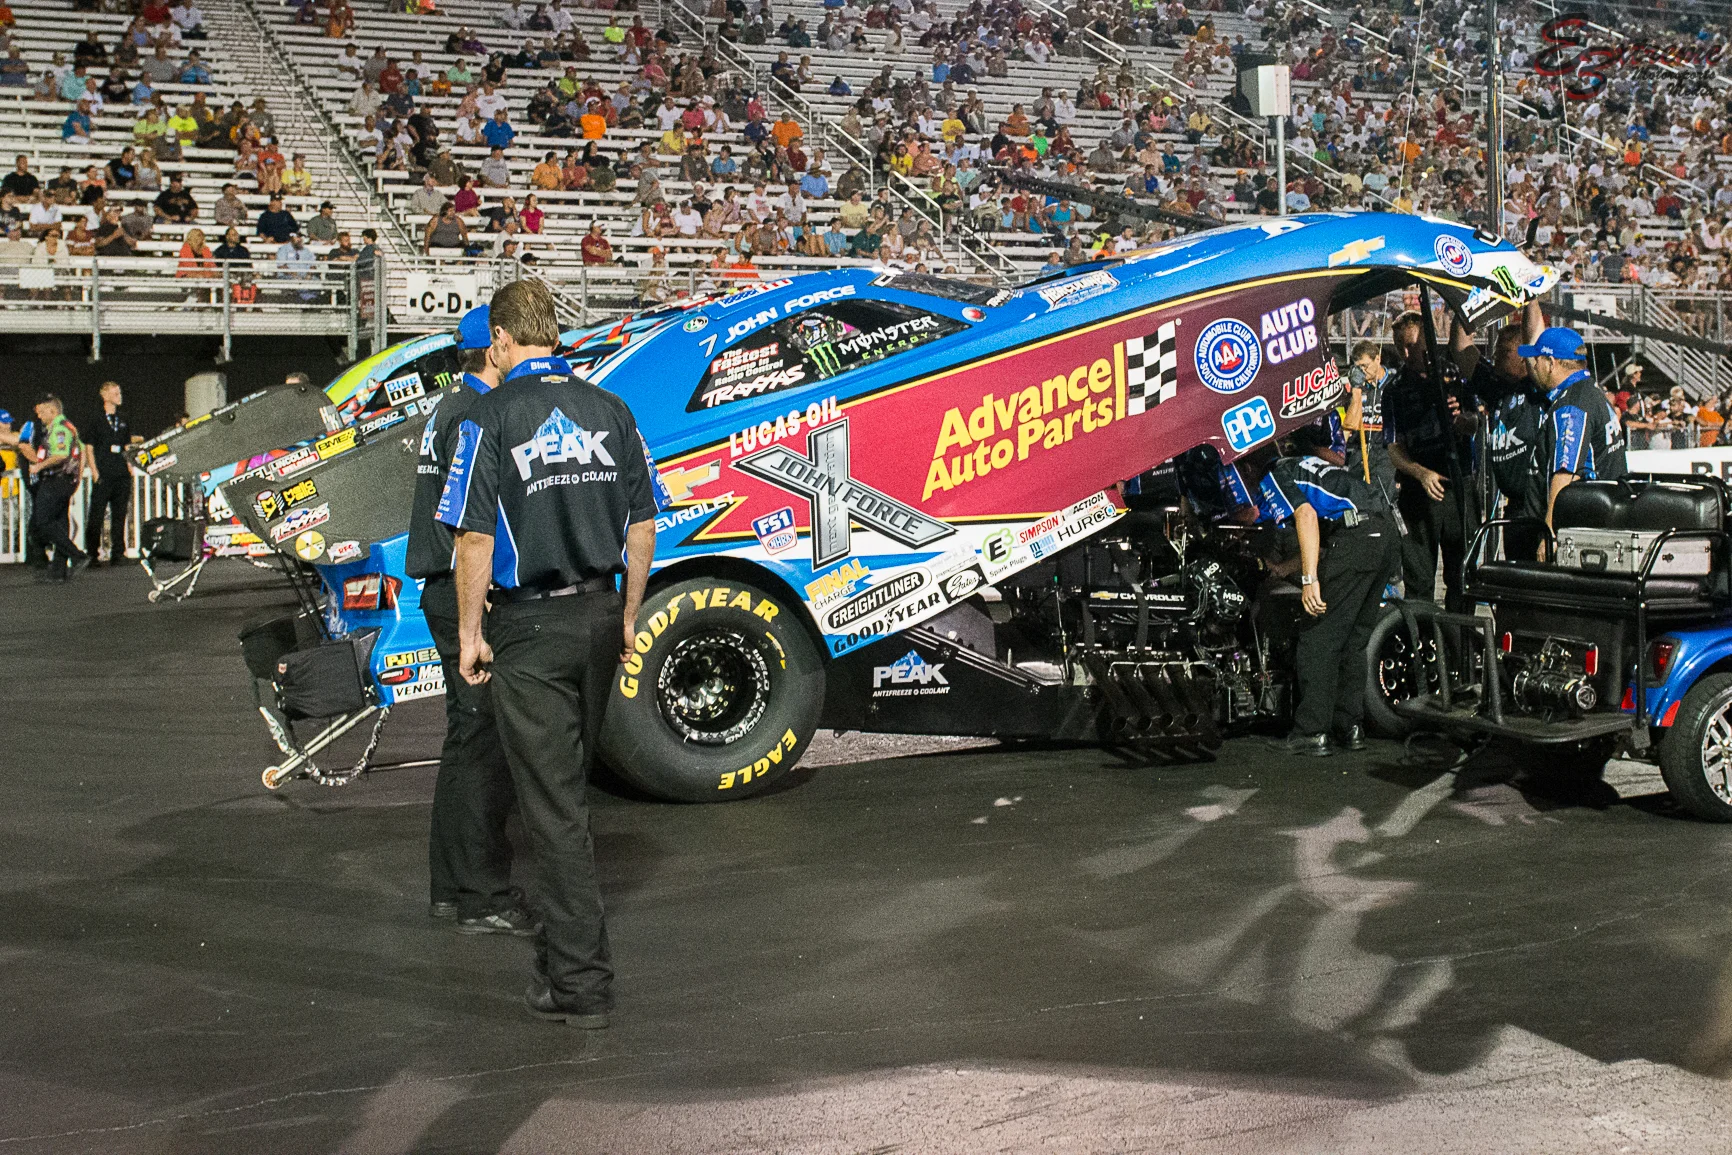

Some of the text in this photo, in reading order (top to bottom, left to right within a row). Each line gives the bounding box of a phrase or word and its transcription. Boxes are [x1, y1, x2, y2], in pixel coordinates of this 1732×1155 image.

[724, 284, 856, 344] JOHN FORCE
[1261, 299, 1315, 341] AUTO
[404, 336, 453, 359] COURTNEY
[698, 333, 718, 358] 7
[722, 347, 743, 360] The
[861, 331, 930, 360] ENERGY
[1198, 321, 1251, 360] AUTOMOBILE CLUB
[1214, 343, 1243, 366] AAA
[1266, 324, 1318, 365] CLUB
[711, 343, 779, 374] Fastest
[714, 358, 784, 387] Radio Control
[726, 361, 755, 376] Name
[1200, 342, 1260, 390] SOUTHERN CALIFORNIA
[387, 377, 418, 392] Blue
[389, 384, 420, 401] DEF
[701, 364, 806, 408] TRAXXAS
[1283, 356, 1340, 404] LUCAS
[934, 357, 1113, 460] Advance
[1287, 391, 1322, 417] SLICK
[360, 411, 400, 433] TREND
[728, 395, 843, 458] LUCAS OIL
[1226, 404, 1271, 444] PPG
[317, 432, 346, 451] BME
[511, 430, 616, 482] PEAK
[921, 396, 1114, 502] Auto Parts
[269, 449, 311, 470] LINCOLN
[526, 474, 570, 497] ANTIEEZE
[770, 456, 925, 537] JOHN FORCE
[655, 491, 735, 533] EVROLET
[1072, 493, 1104, 514] ACTION
[758, 510, 793, 536] FS1
[1019, 515, 1060, 544] SIMPSON
[1057, 504, 1117, 542] HURCO
[767, 533, 793, 549] NHRA
[805, 558, 870, 602] FINAL
[989, 563, 1009, 578] Spark
[1009, 554, 1028, 569] Plugs
[814, 584, 857, 610] CHARGE
[831, 573, 921, 628] FREIGHTLINER
[1120, 592, 1185, 602] CHVROLET
[1222, 591, 1244, 602] MSD
[834, 590, 941, 653] GOODYEAR
[620, 587, 780, 699] GOODYEAR
[386, 652, 415, 668] PJ1
[752, 649, 770, 691] WELD
[873, 662, 950, 688] PEAK
[873, 686, 950, 698] ANTIFREEZE COOLANT
[717, 728, 798, 790] EAGLE
